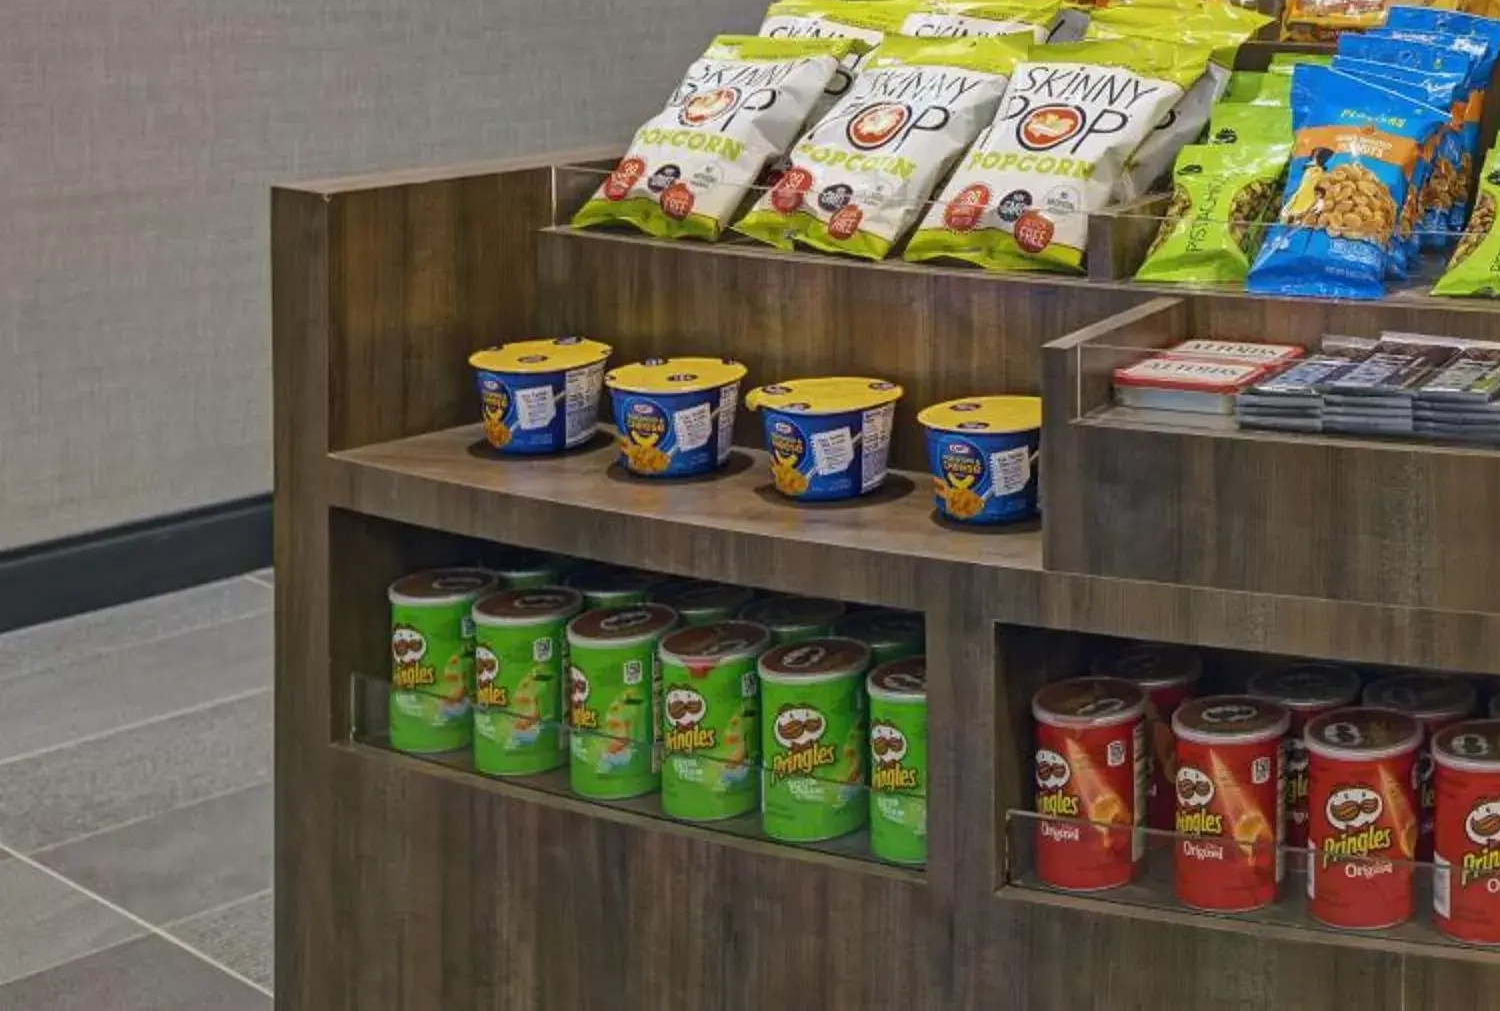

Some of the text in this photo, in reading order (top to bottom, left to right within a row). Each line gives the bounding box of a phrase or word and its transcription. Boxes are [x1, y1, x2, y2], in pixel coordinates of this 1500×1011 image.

[1026, 66, 1158, 105] SKINNY
[637, 127, 746, 163] POPCORN
[968, 150, 1096, 180] POPCORN
[667, 725, 716, 753] ringles
[772, 742, 836, 782] Pringles
[1040, 820, 1080, 842] Original
[1182, 840, 1225, 861] Original
[1322, 825, 1391, 869] Pringles
[1344, 861, 1393, 879] Original
